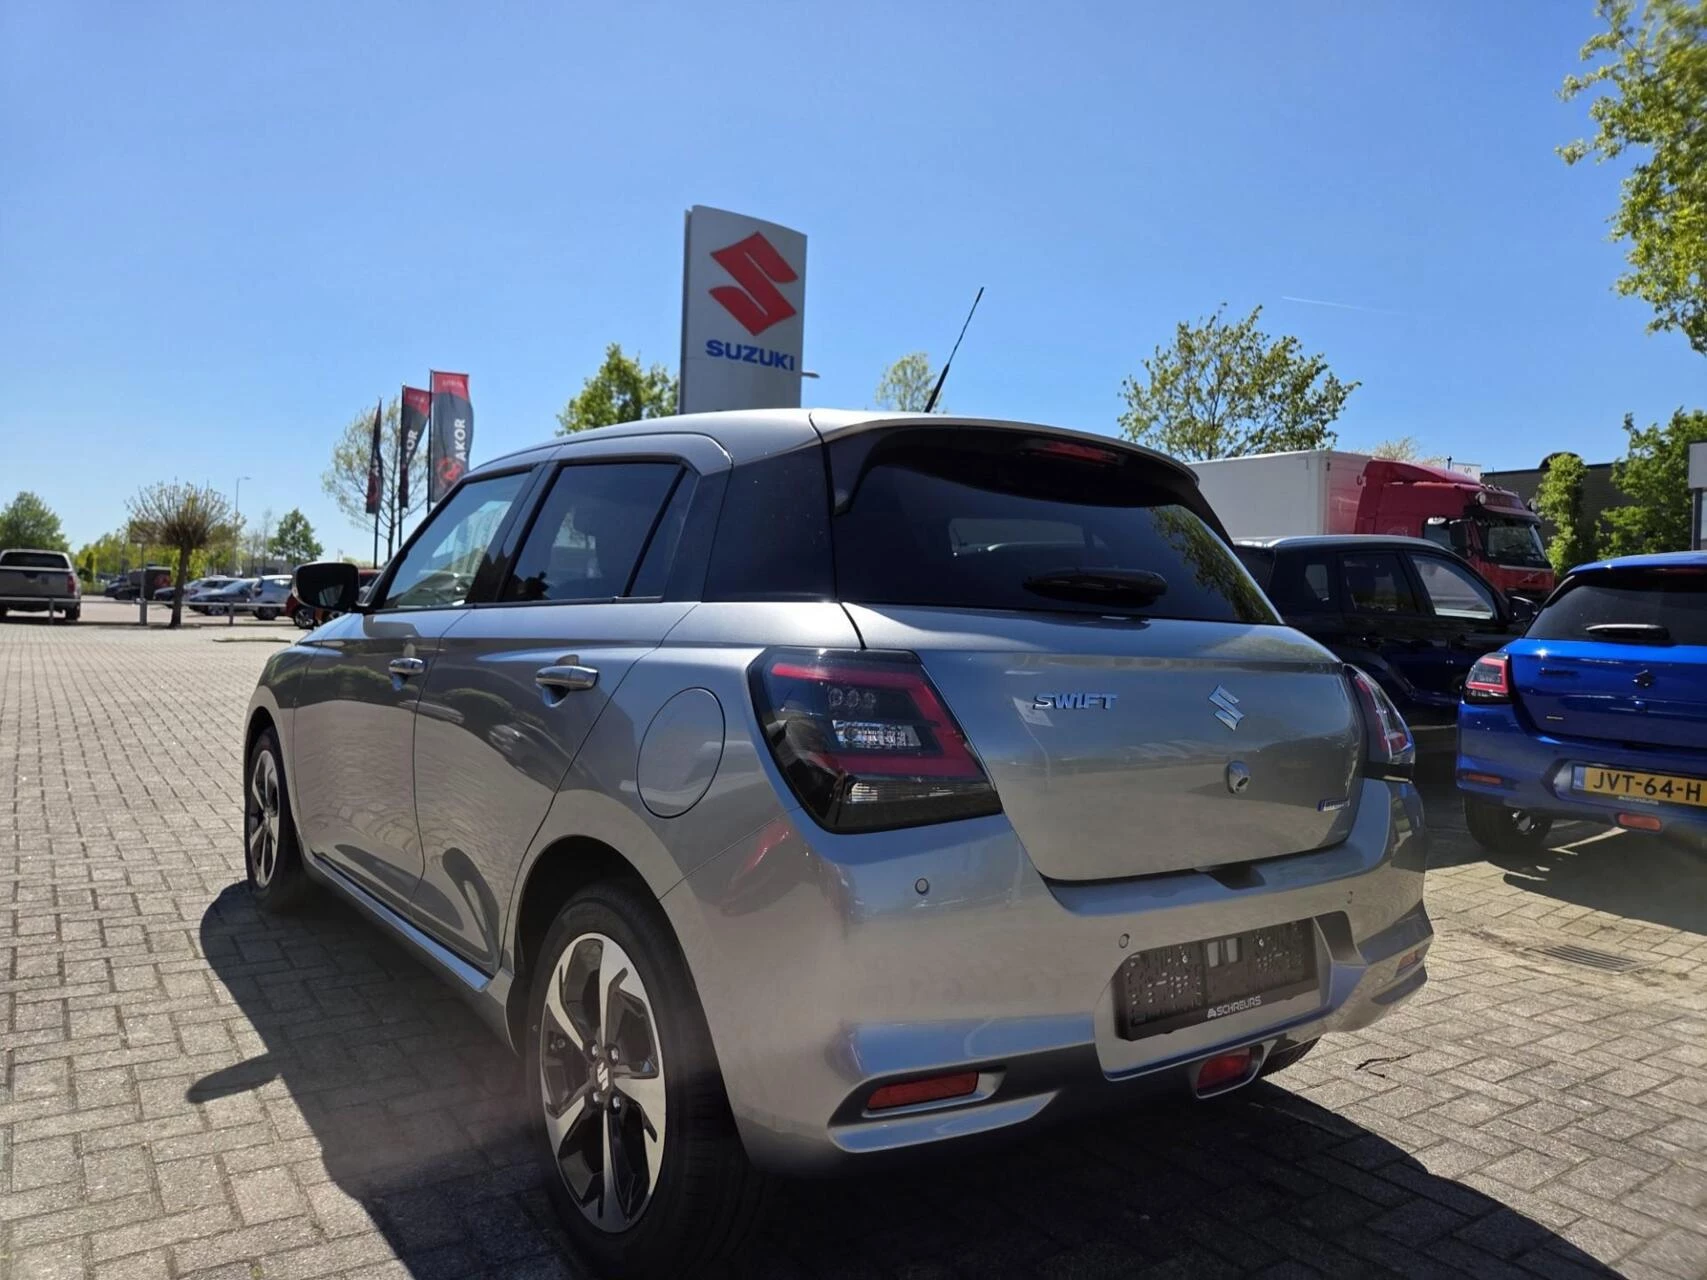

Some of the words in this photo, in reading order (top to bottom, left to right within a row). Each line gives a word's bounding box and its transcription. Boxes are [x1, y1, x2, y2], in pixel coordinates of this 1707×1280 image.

[705, 339, 796, 371] SUZUKI
[1032, 692, 1118, 710] SWIFT
[1593, 771, 1702, 802] JVT-64-H
[1216, 995, 1262, 1017] SCHREURS
